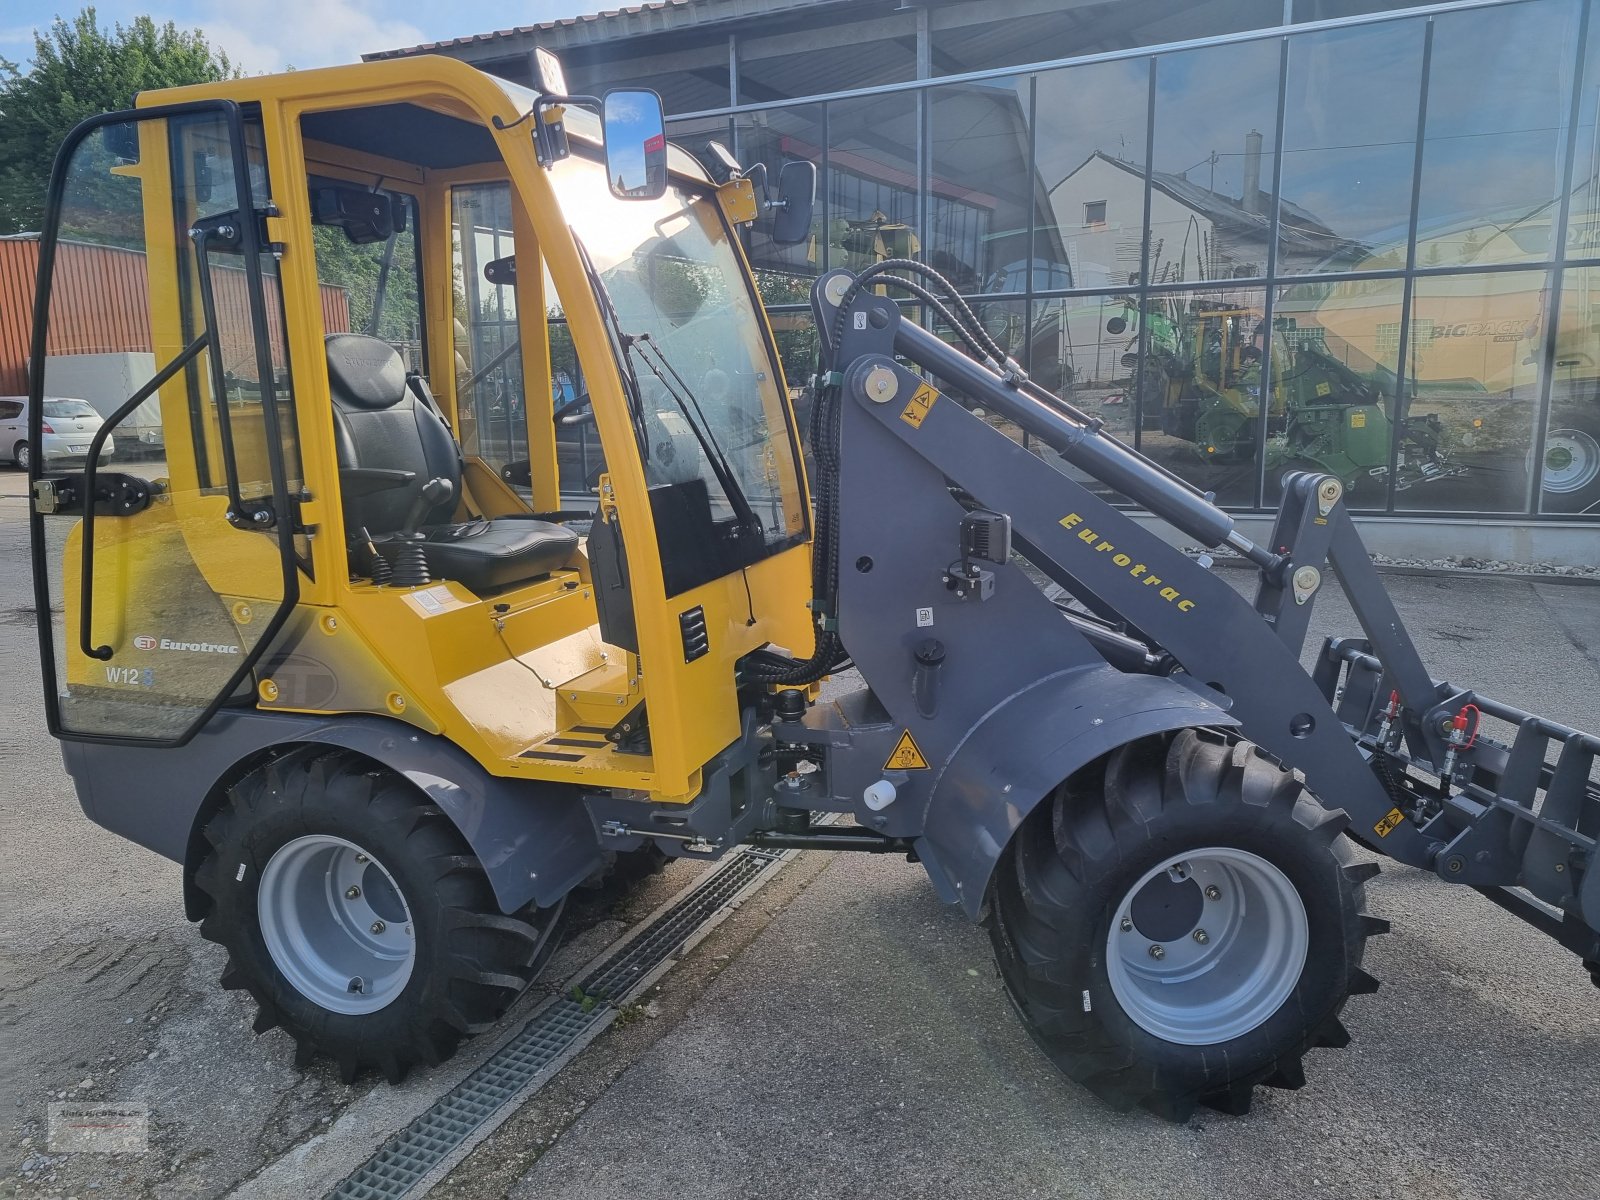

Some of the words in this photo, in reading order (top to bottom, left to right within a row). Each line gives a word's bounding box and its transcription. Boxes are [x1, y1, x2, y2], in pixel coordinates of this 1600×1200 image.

[1058, 512, 1196, 612] Eurotrac
[160, 638, 238, 654] Eurotrac
[106, 666, 139, 685] W12
